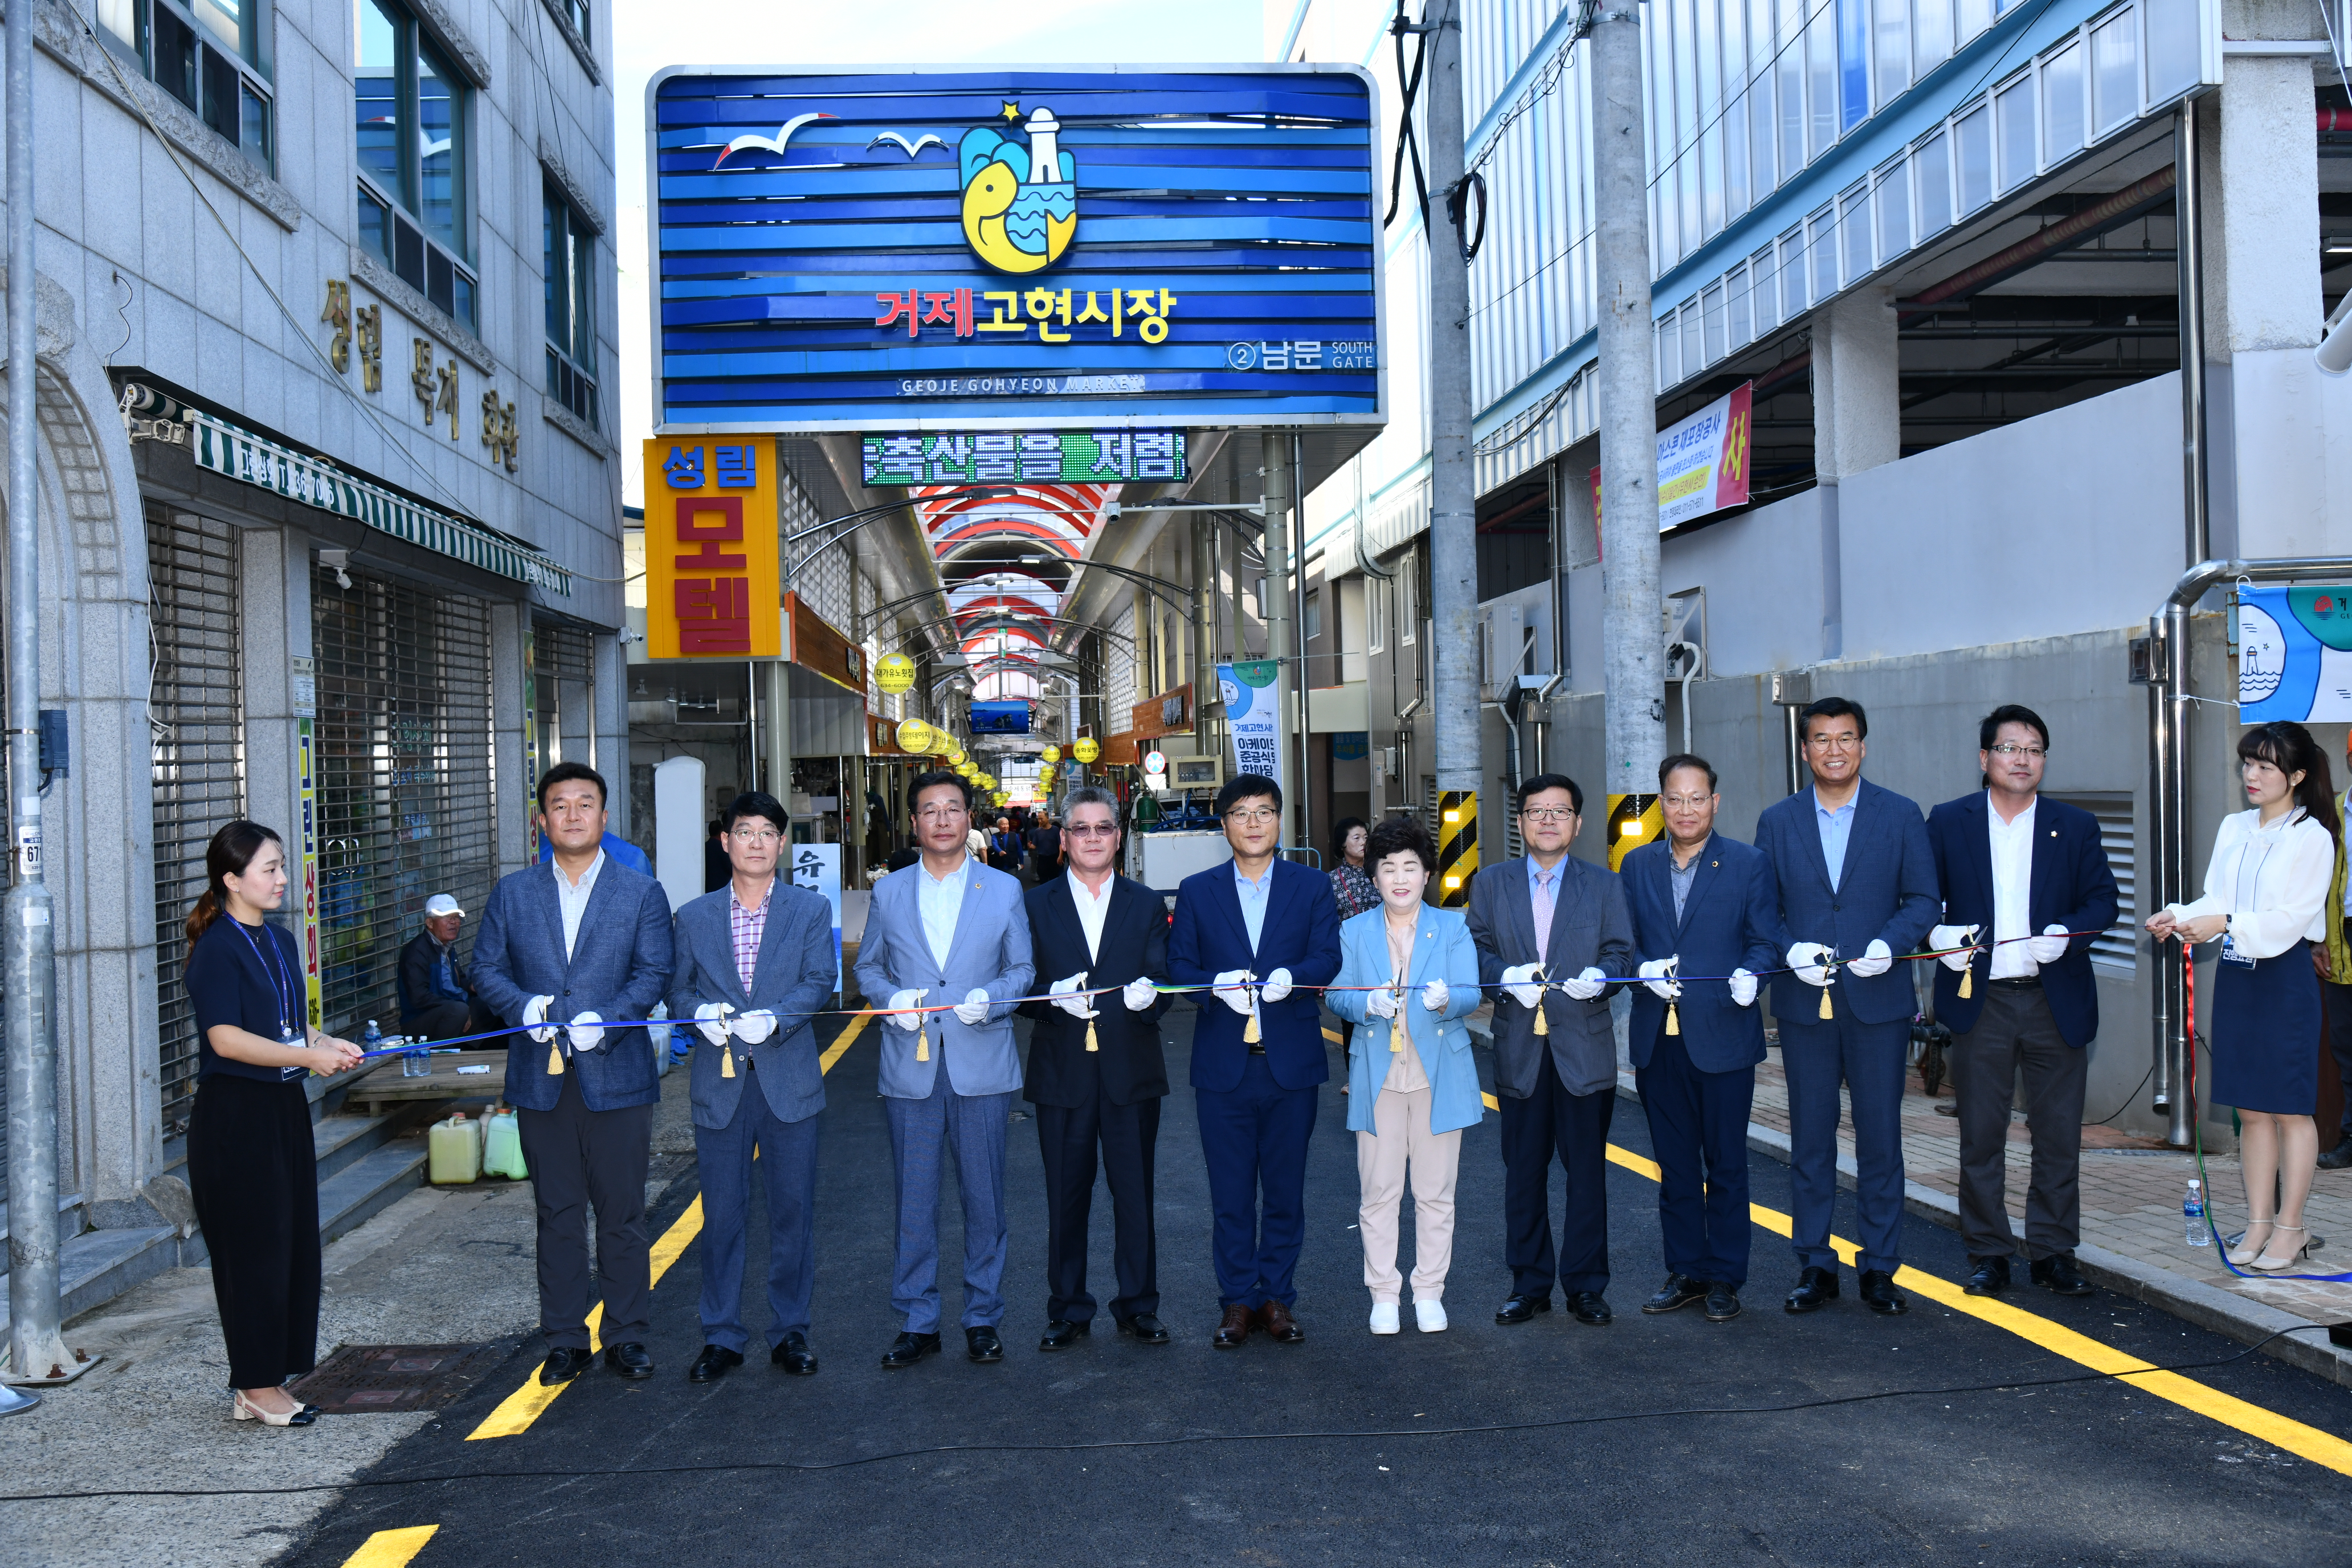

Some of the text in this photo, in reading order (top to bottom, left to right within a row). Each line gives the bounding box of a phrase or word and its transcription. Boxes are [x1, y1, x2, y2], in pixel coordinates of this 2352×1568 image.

[1261, 341, 1322, 370] 남문
[1332, 342, 1372, 354] SOUTH
[1332, 356, 1373, 368] GATE
[902, 375, 1140, 393] GEOJE GOHYEON MARKET
[1679, 410, 1721, 452] 재포장공사
[661, 445, 757, 489] 성림
[863, 433, 1186, 482] 축산물을 저렴
[674, 496, 752, 652] 모텔
[301, 734, 318, 979] 그린상회
